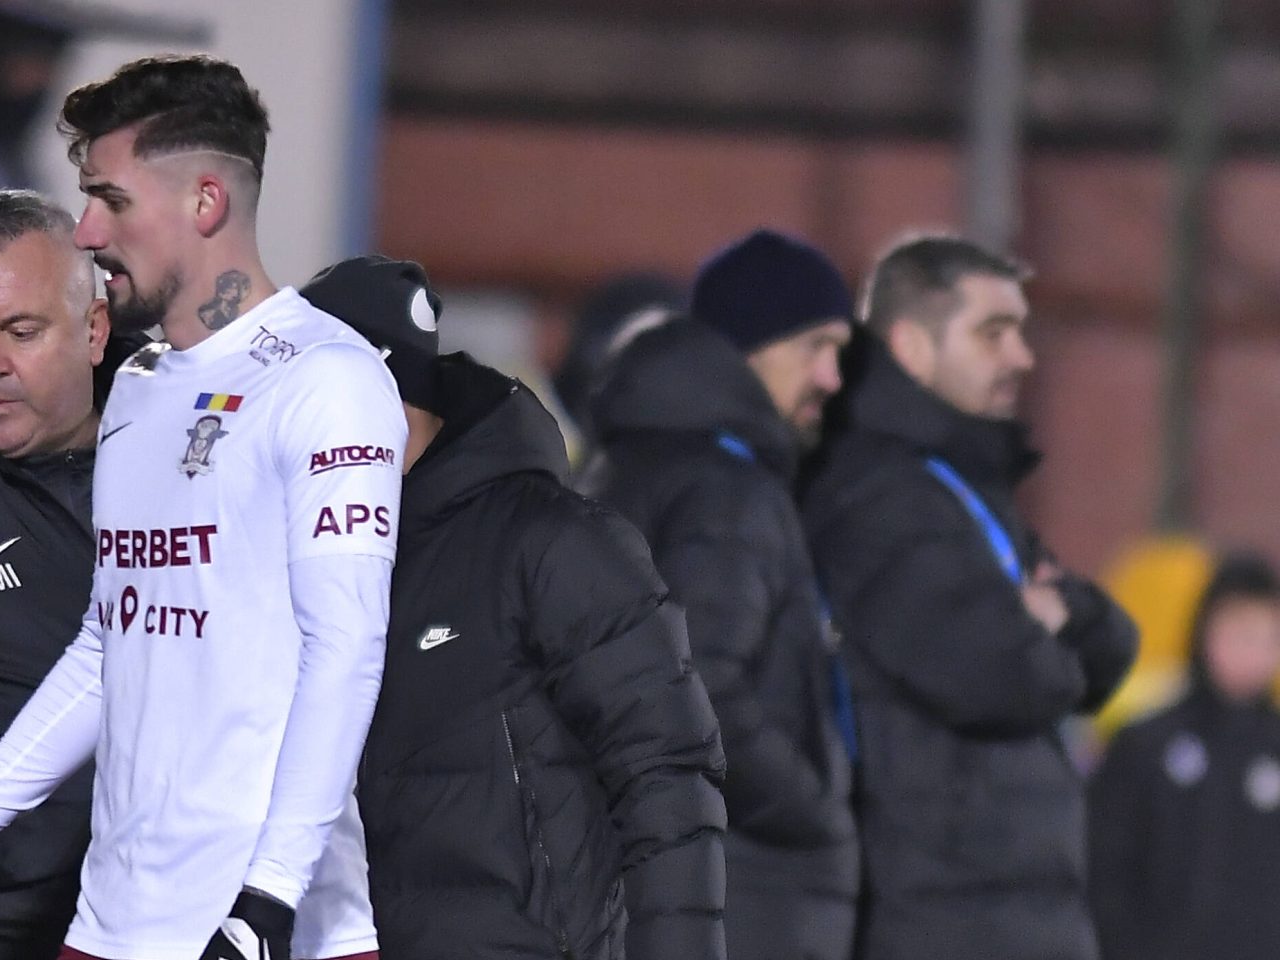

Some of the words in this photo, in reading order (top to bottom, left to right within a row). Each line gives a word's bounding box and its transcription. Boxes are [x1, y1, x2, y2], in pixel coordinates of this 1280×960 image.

[309, 445, 395, 471] AUTOCAR
[312, 503, 391, 538] APS
[96, 524, 218, 569] PERBET
[145, 604, 210, 639] CITY
